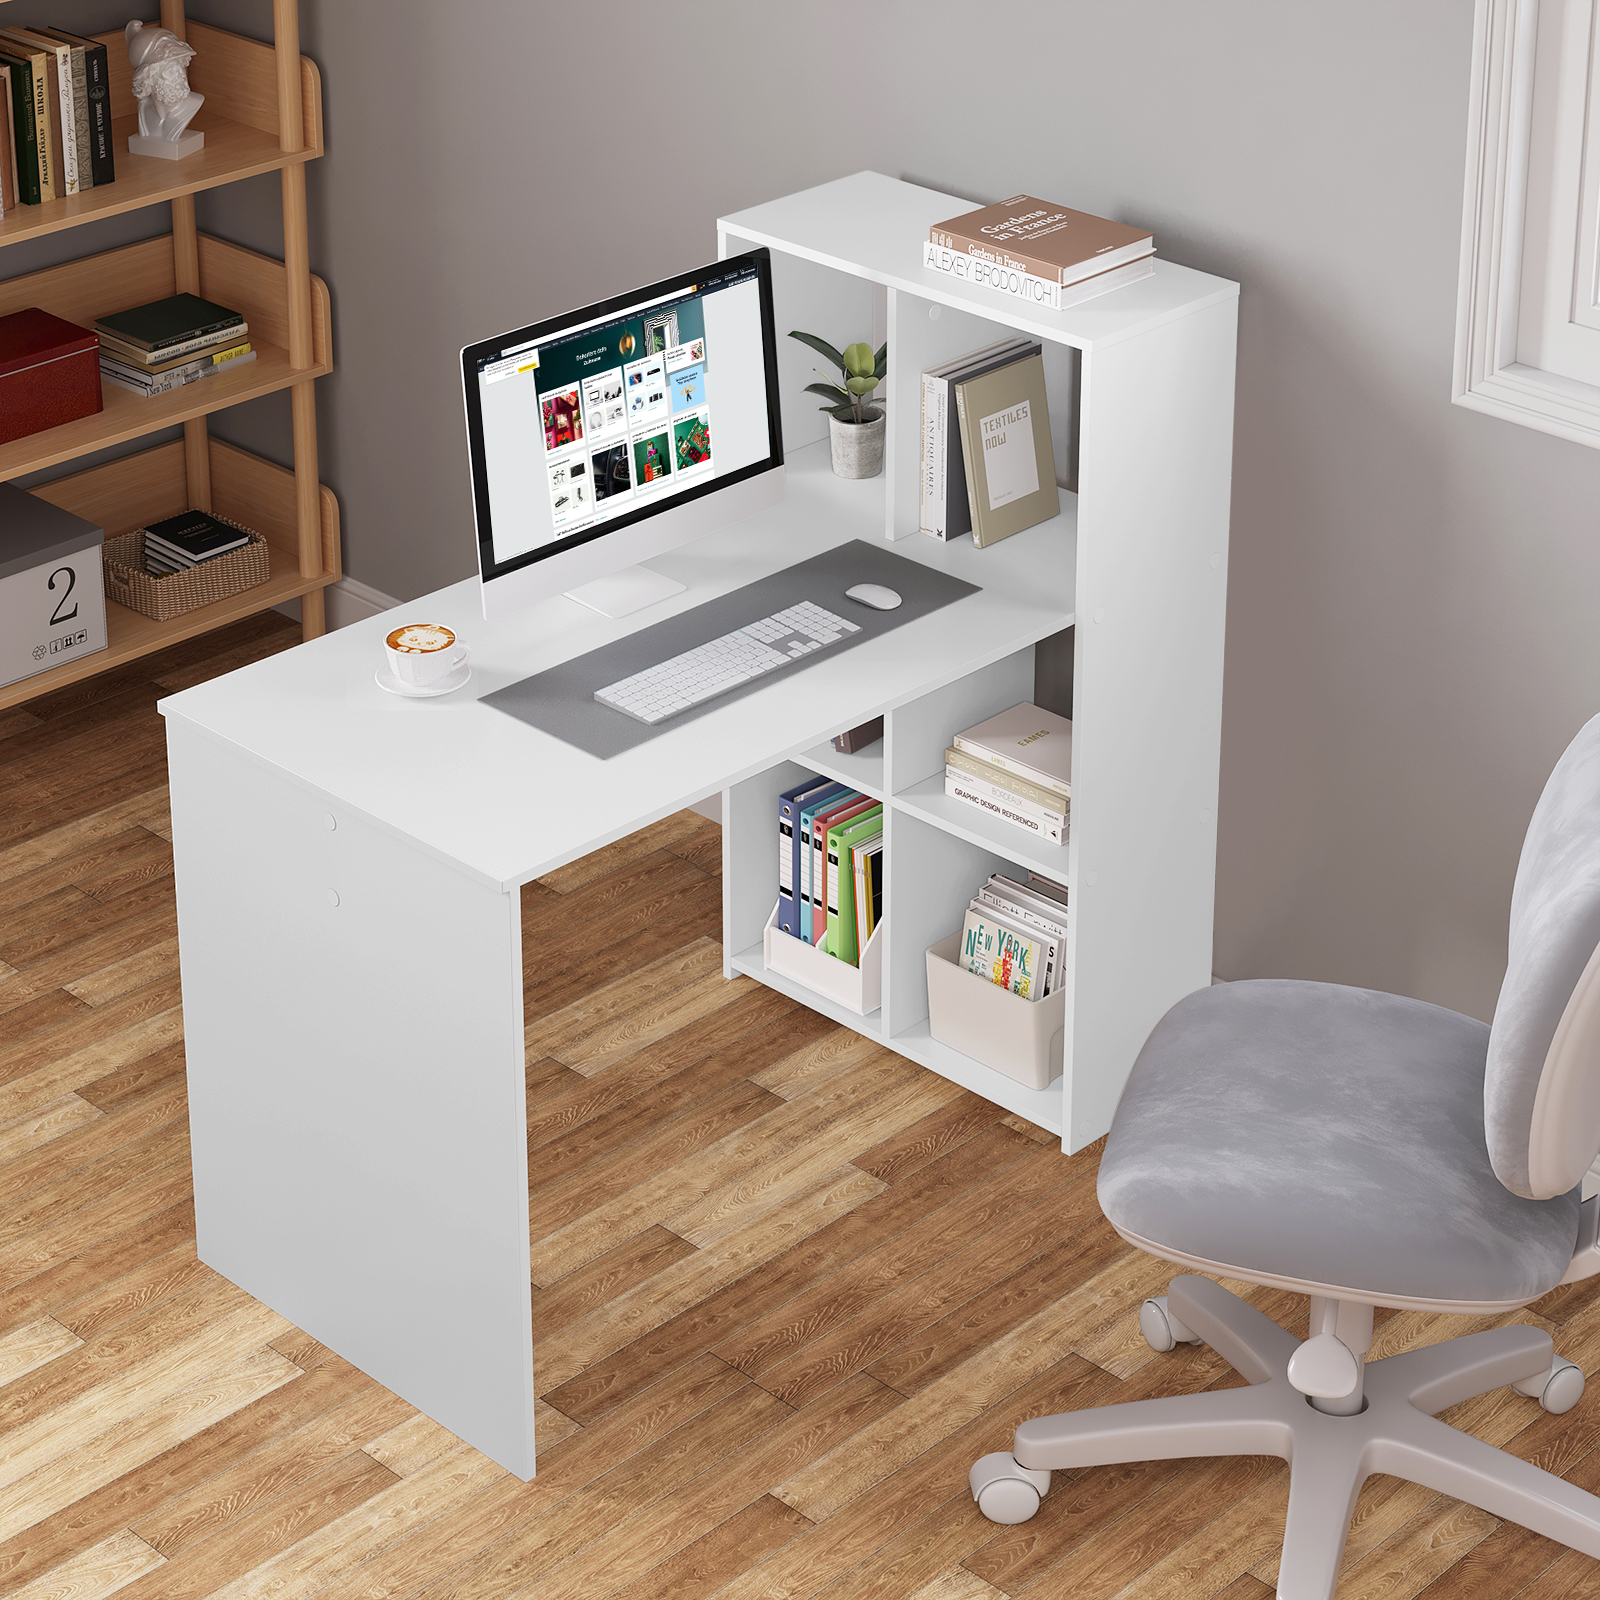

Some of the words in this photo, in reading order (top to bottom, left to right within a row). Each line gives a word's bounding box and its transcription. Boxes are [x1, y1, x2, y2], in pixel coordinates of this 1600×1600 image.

[36, 77, 45, 116] ШКОЛА
[26, 103, 35, 142] Виталий
[66, 146, 77, 178] Сказки
[980, 209, 1048, 234] Gardens
[990, 229, 1010, 242] in
[1013, 212, 1067, 237] France
[968, 243, 995, 264] Gardens
[995, 251, 1003, 265] in
[1003, 254, 1027, 273] France
[926, 247, 972, 278] ALEXEY
[975, 261, 1052, 304] BRODOVITCH
[149, 386, 160, 397] New
[159, 380, 173, 393] York
[983, 405, 1029, 434] TEXTILES
[47, 566, 79, 627] 2
[1017, 729, 1050, 747] EAMES
[991, 756, 1006, 768] EAMES
[954, 787, 979, 804] GRAPHIC
[980, 798, 1001, 814] DESIGN
[1001, 808, 1039, 831] REFERENCED
[991, 787, 1023, 807] BORDEAUX
[965, 924, 993, 957] NEW
[998, 929, 1028, 973] YORK
